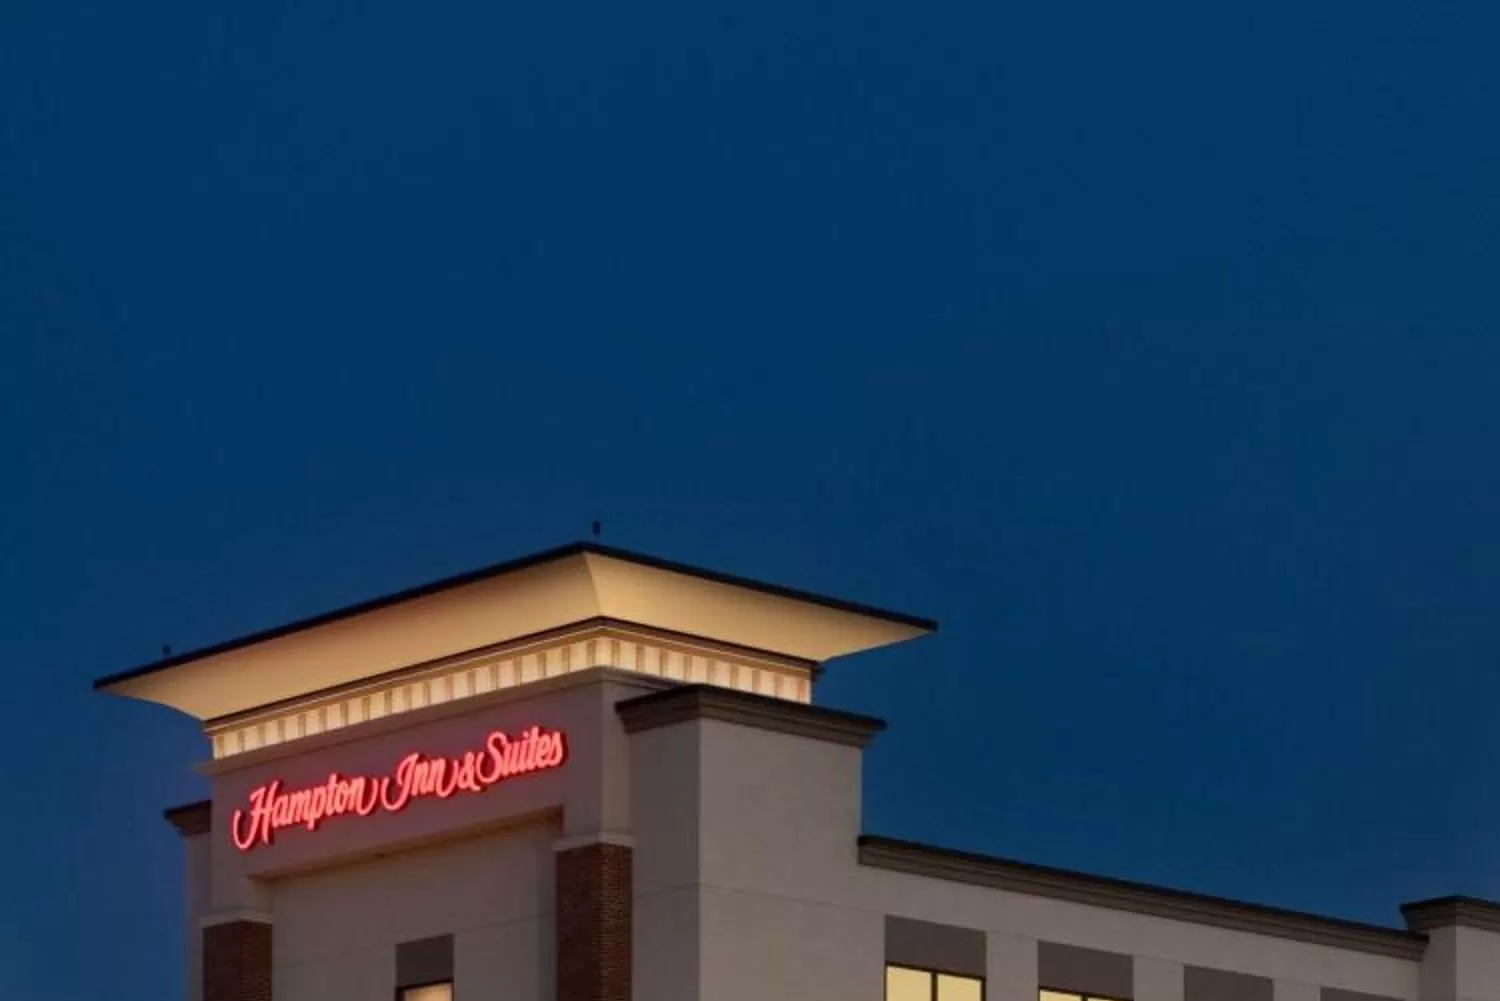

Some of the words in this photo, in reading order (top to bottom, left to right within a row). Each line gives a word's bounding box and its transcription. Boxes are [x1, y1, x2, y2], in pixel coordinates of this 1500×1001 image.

[232, 773, 379, 850] Hampton
[380, 752, 460, 811] Inn
[456, 751, 481, 792] &
[475, 725, 564, 784] Suites
